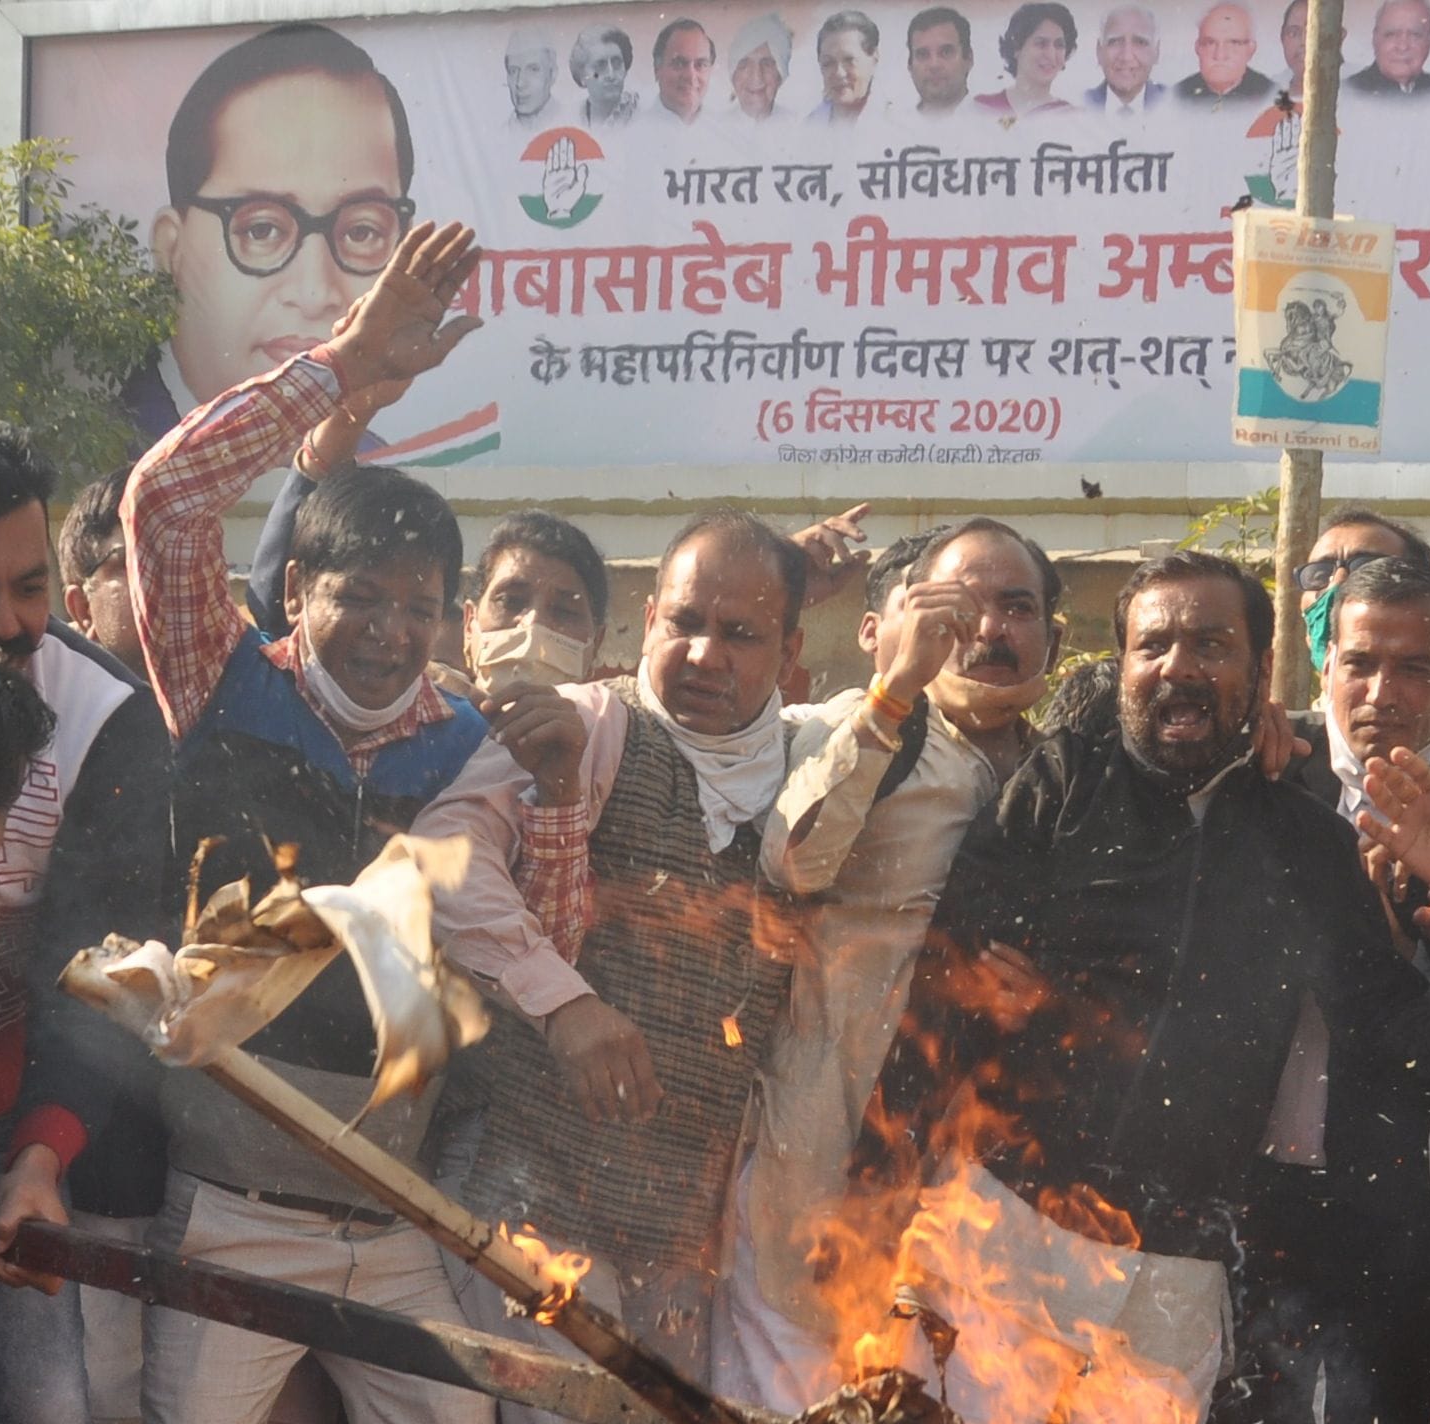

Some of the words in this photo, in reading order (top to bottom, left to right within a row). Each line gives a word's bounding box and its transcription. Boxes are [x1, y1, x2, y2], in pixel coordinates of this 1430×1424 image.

[664, 164, 763, 206] भारत
[772, 164, 843, 208] रत्न,
[857, 145, 1020, 200] संविधान
[1031, 139, 1175, 197] निर्माता
[815, 214, 1078, 307] भीमराव
[529, 334, 571, 386] के
[579, 327, 845, 386] महापरिनिर्वाण
[854, 326, 970, 379] दिवस
[981, 338, 1036, 377] पर
[1048, 336, 1218, 390] शत्-शत्
[756, 399, 793, 441] (6
[805, 388, 939, 433] दिसम्बर
[950, 396, 1062, 440] 2020)
[1235, 428, 1278, 444] Rani
[1284, 431, 1341, 447] Laxmi
[777, 443, 818, 464] जिला
[876, 443, 926, 464] कमेटी
[986, 443, 1043, 464] रोहतक
